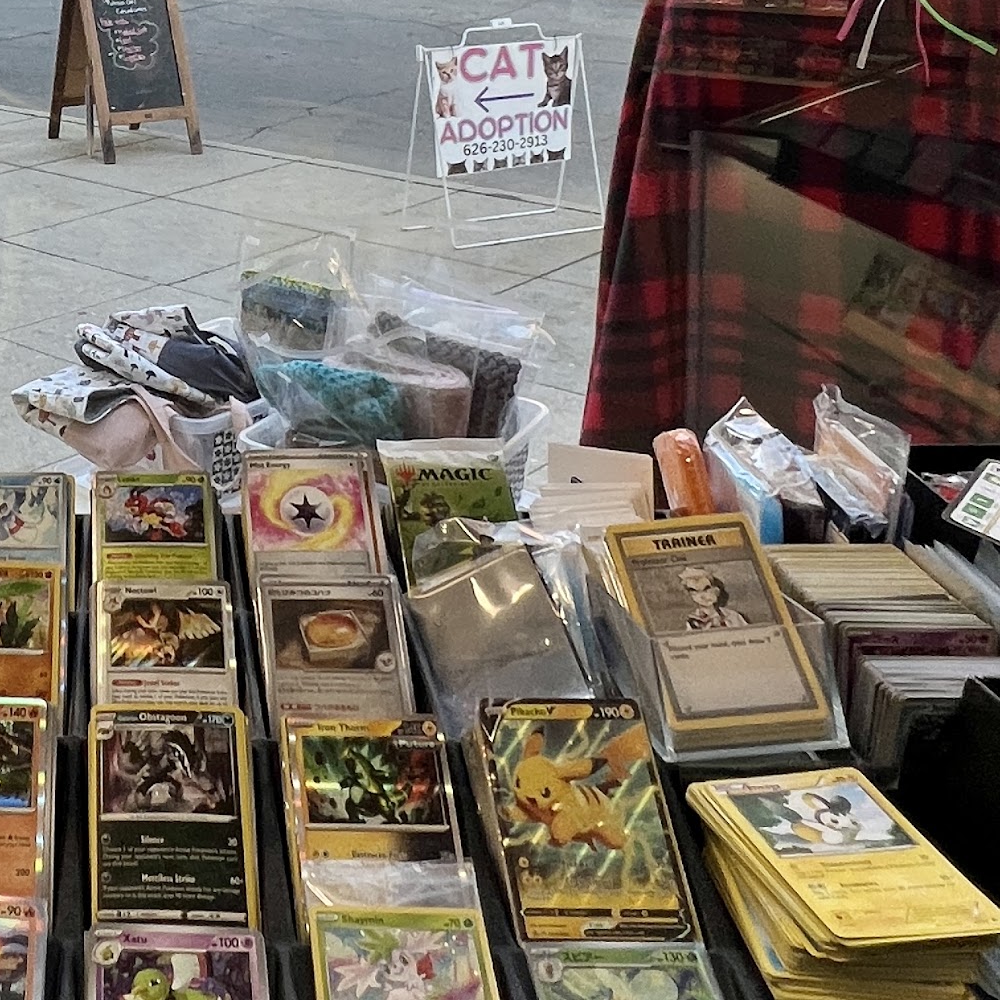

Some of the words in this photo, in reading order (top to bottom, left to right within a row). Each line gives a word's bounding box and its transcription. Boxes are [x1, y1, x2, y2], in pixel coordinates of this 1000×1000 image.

[460, 43, 544, 83] CAT
[440, 108, 568, 144] ADOPTION
[463, 134, 549, 156] 626-230-2913
[418, 467, 493, 481] MAGIC
[652, 534, 717, 550] TRAINER
[198, 588, 213, 596] 100
[9, 707, 27, 718] 140
[600, 706, 620, 718] 190
[139, 712, 188, 726] Obstagoon
[317, 723, 337, 732] Iron
[7, 905, 21, 916] 90
[341, 915, 385, 926] Shaymin
[122, 933, 148, 944] Xatu
[219, 936, 239, 949] 100
[661, 951, 684, 962] 130
